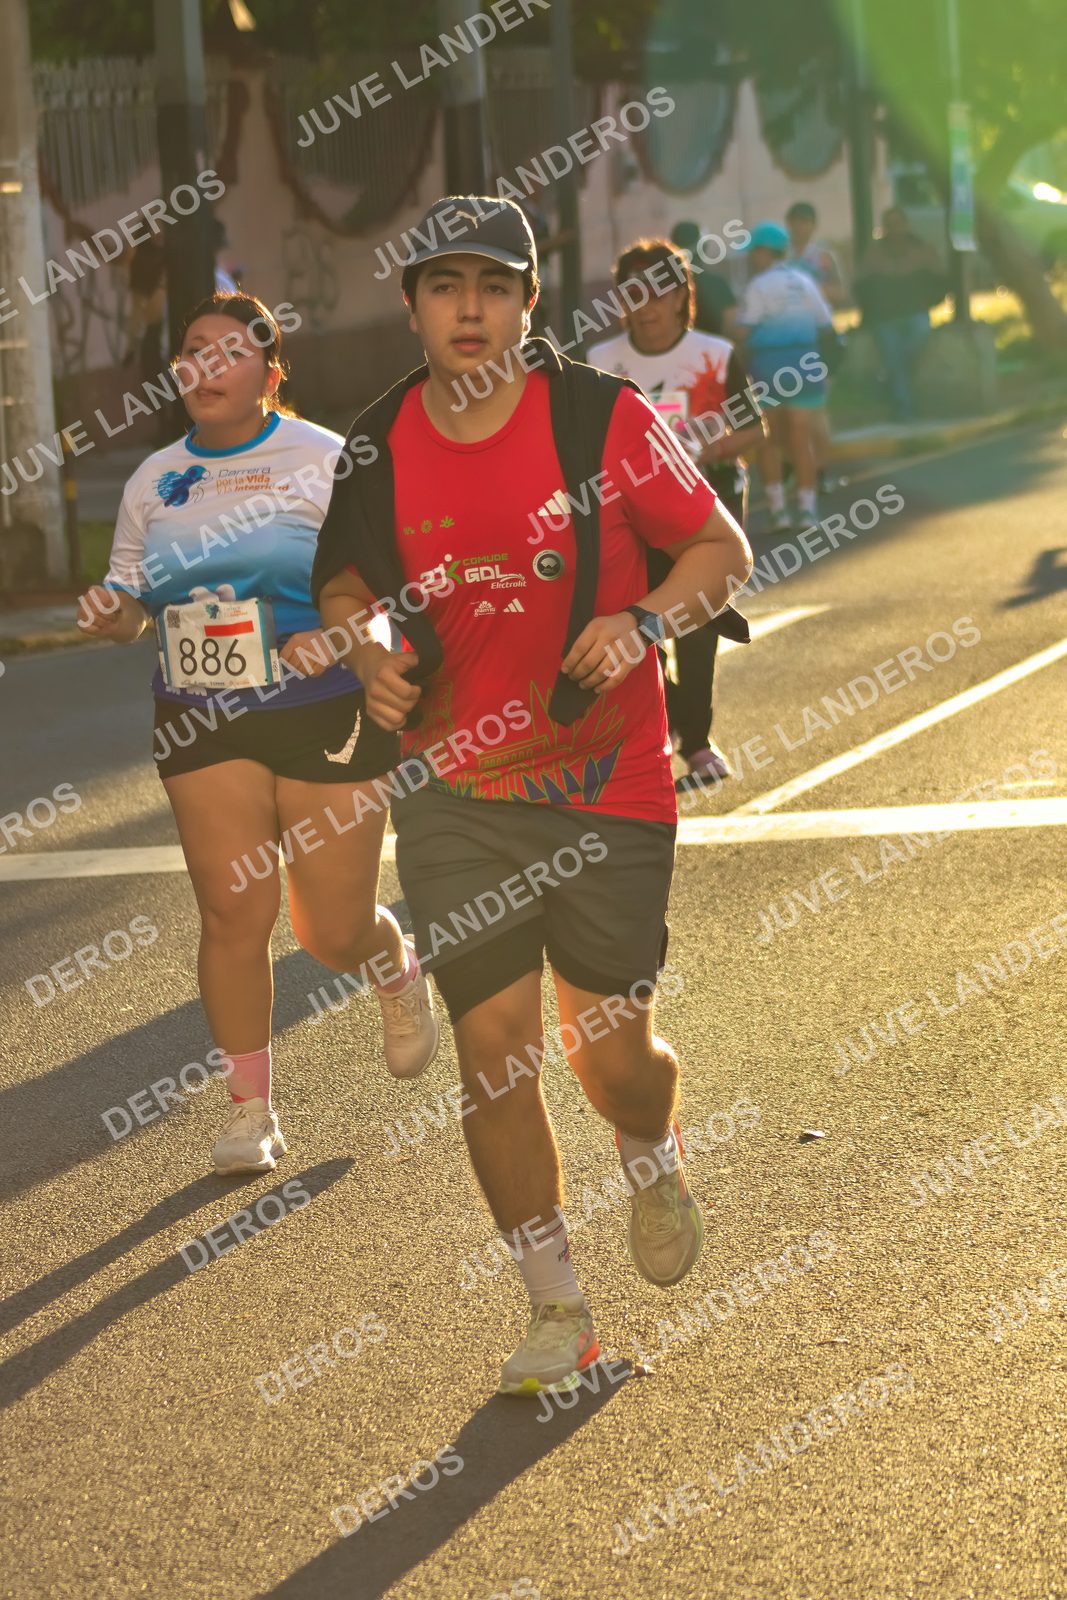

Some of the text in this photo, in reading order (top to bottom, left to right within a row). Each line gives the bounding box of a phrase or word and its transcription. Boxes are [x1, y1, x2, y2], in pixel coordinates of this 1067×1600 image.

[219, 467, 271, 477] Carrera
[216, 478, 232, 488] por
[247, 474, 270, 483] Vida
[462, 553, 510, 567] COMUDE
[464, 564, 510, 584] GDL
[179, 637, 247, 676] 886
